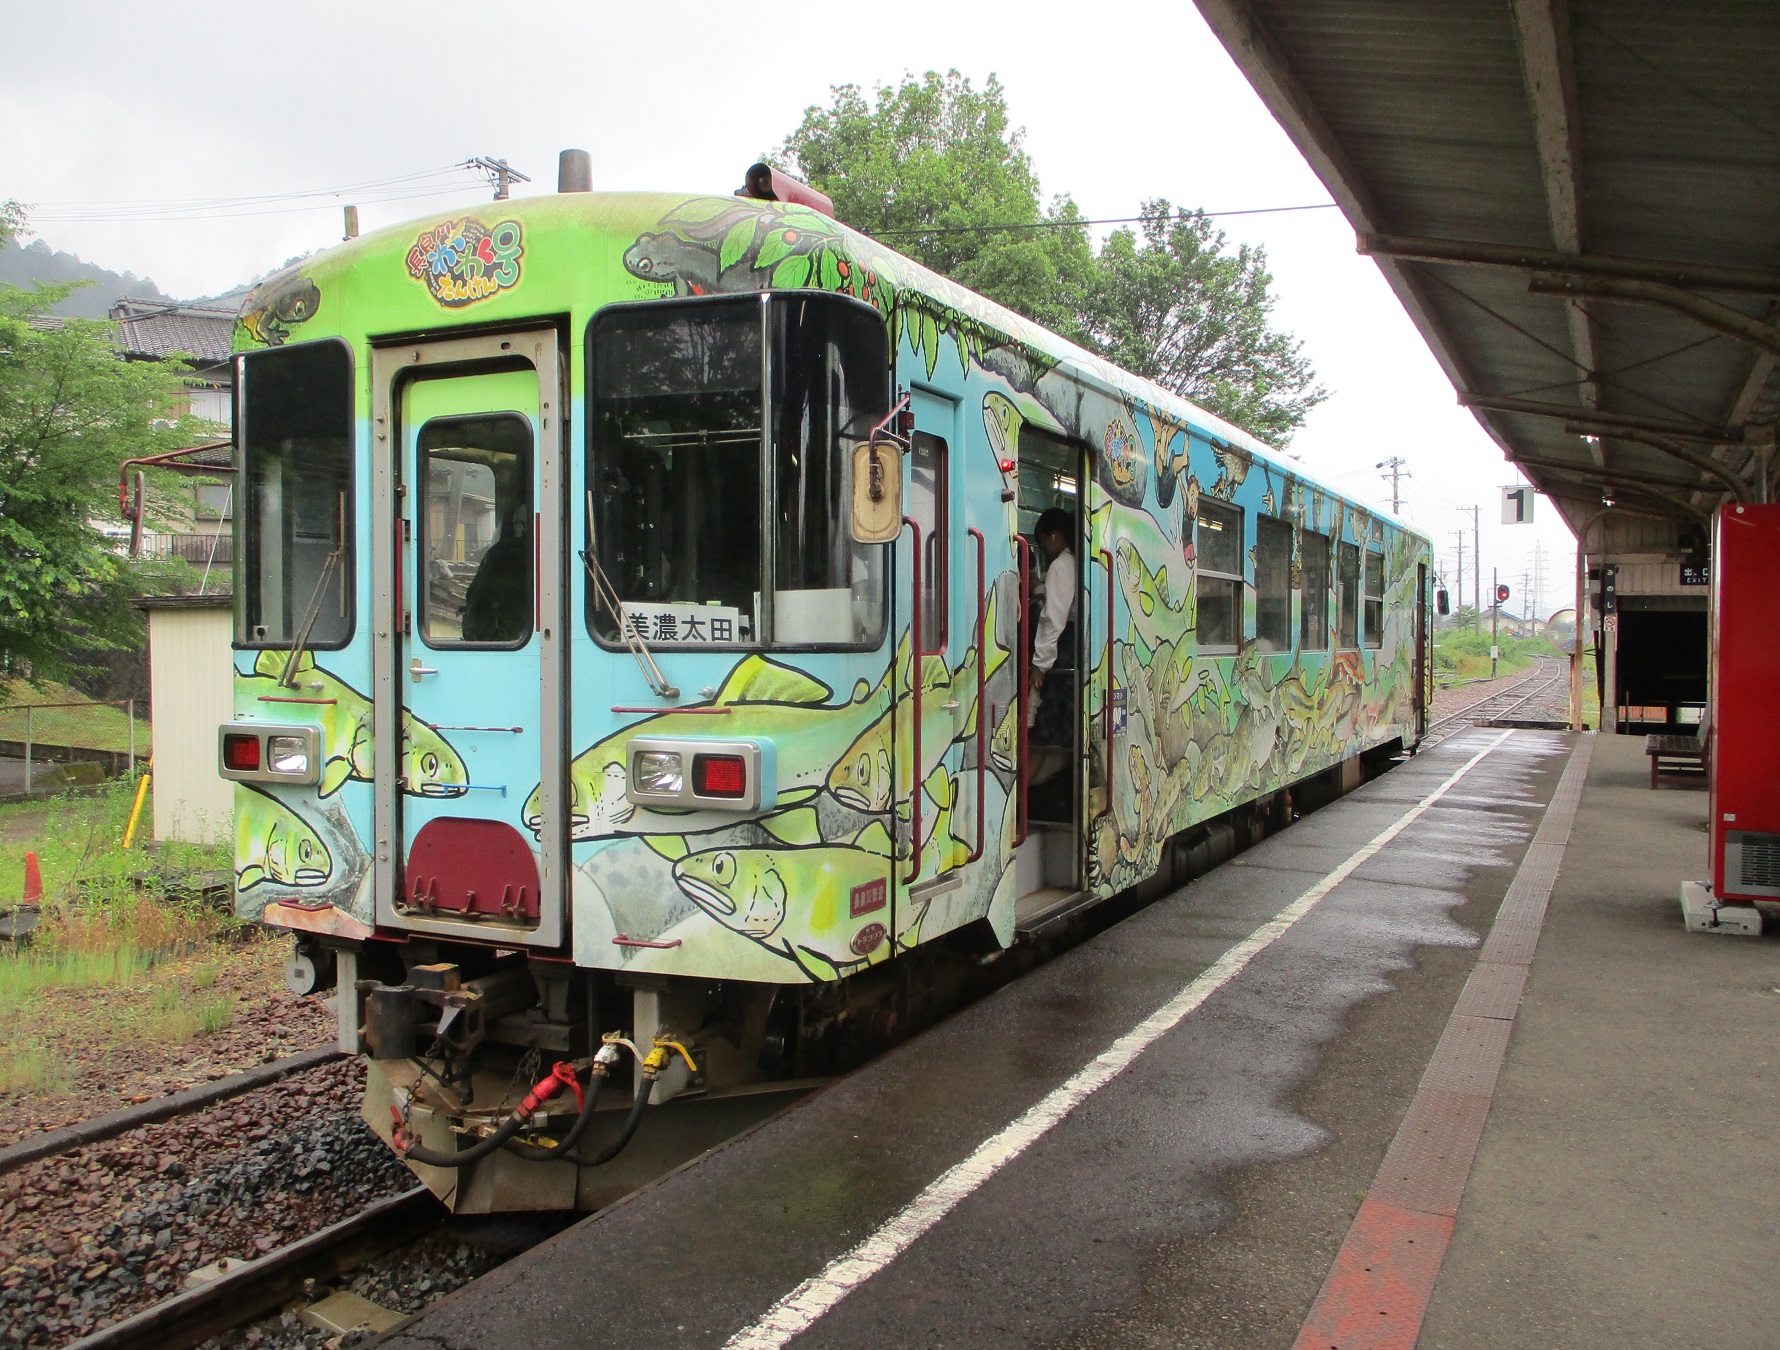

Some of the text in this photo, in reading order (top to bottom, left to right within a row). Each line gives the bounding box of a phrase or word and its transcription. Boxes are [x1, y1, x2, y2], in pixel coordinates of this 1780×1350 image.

[407, 223, 453, 276] 長良川
[437, 273, 498, 301] たんけん
[1507, 489, 1525, 522] 1
[1606, 569, 1614, 609] みのし
[625, 612, 733, 642] 美濃太田
